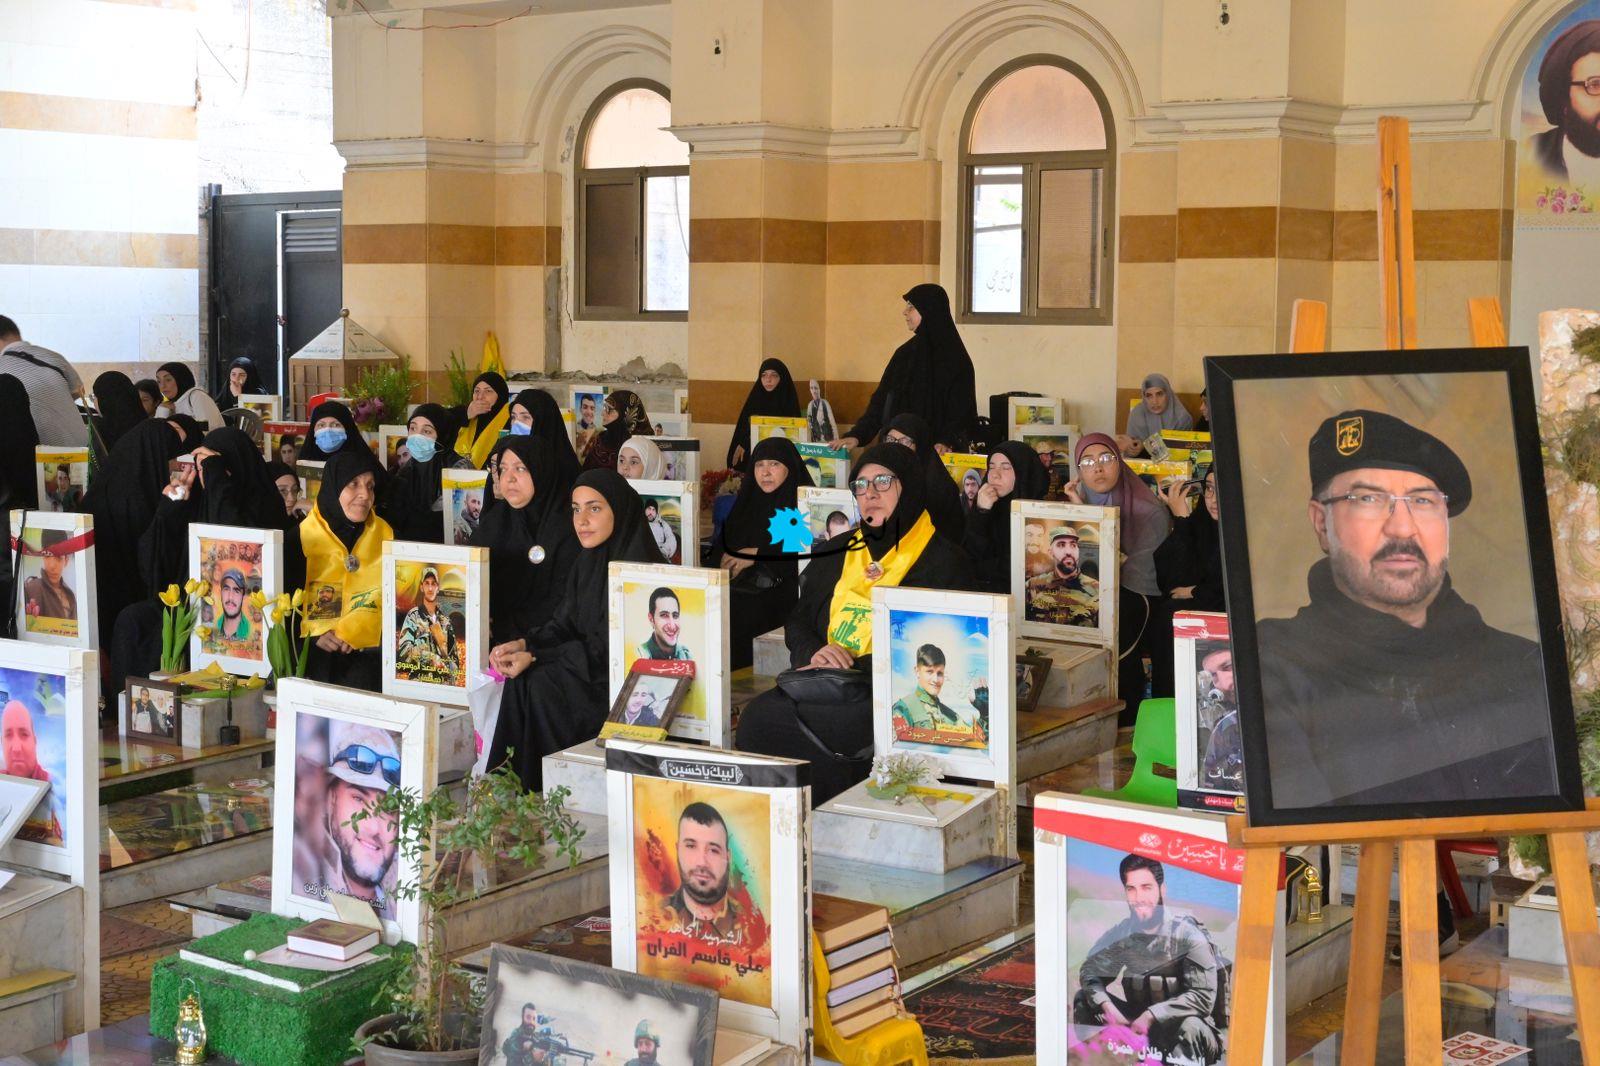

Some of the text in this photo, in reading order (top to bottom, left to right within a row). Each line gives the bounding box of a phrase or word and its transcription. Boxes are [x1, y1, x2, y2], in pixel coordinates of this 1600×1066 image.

[701, 929, 742, 946] الشهيد
[691, 949, 731, 965] قاسم
[736, 955, 764, 977] علي
